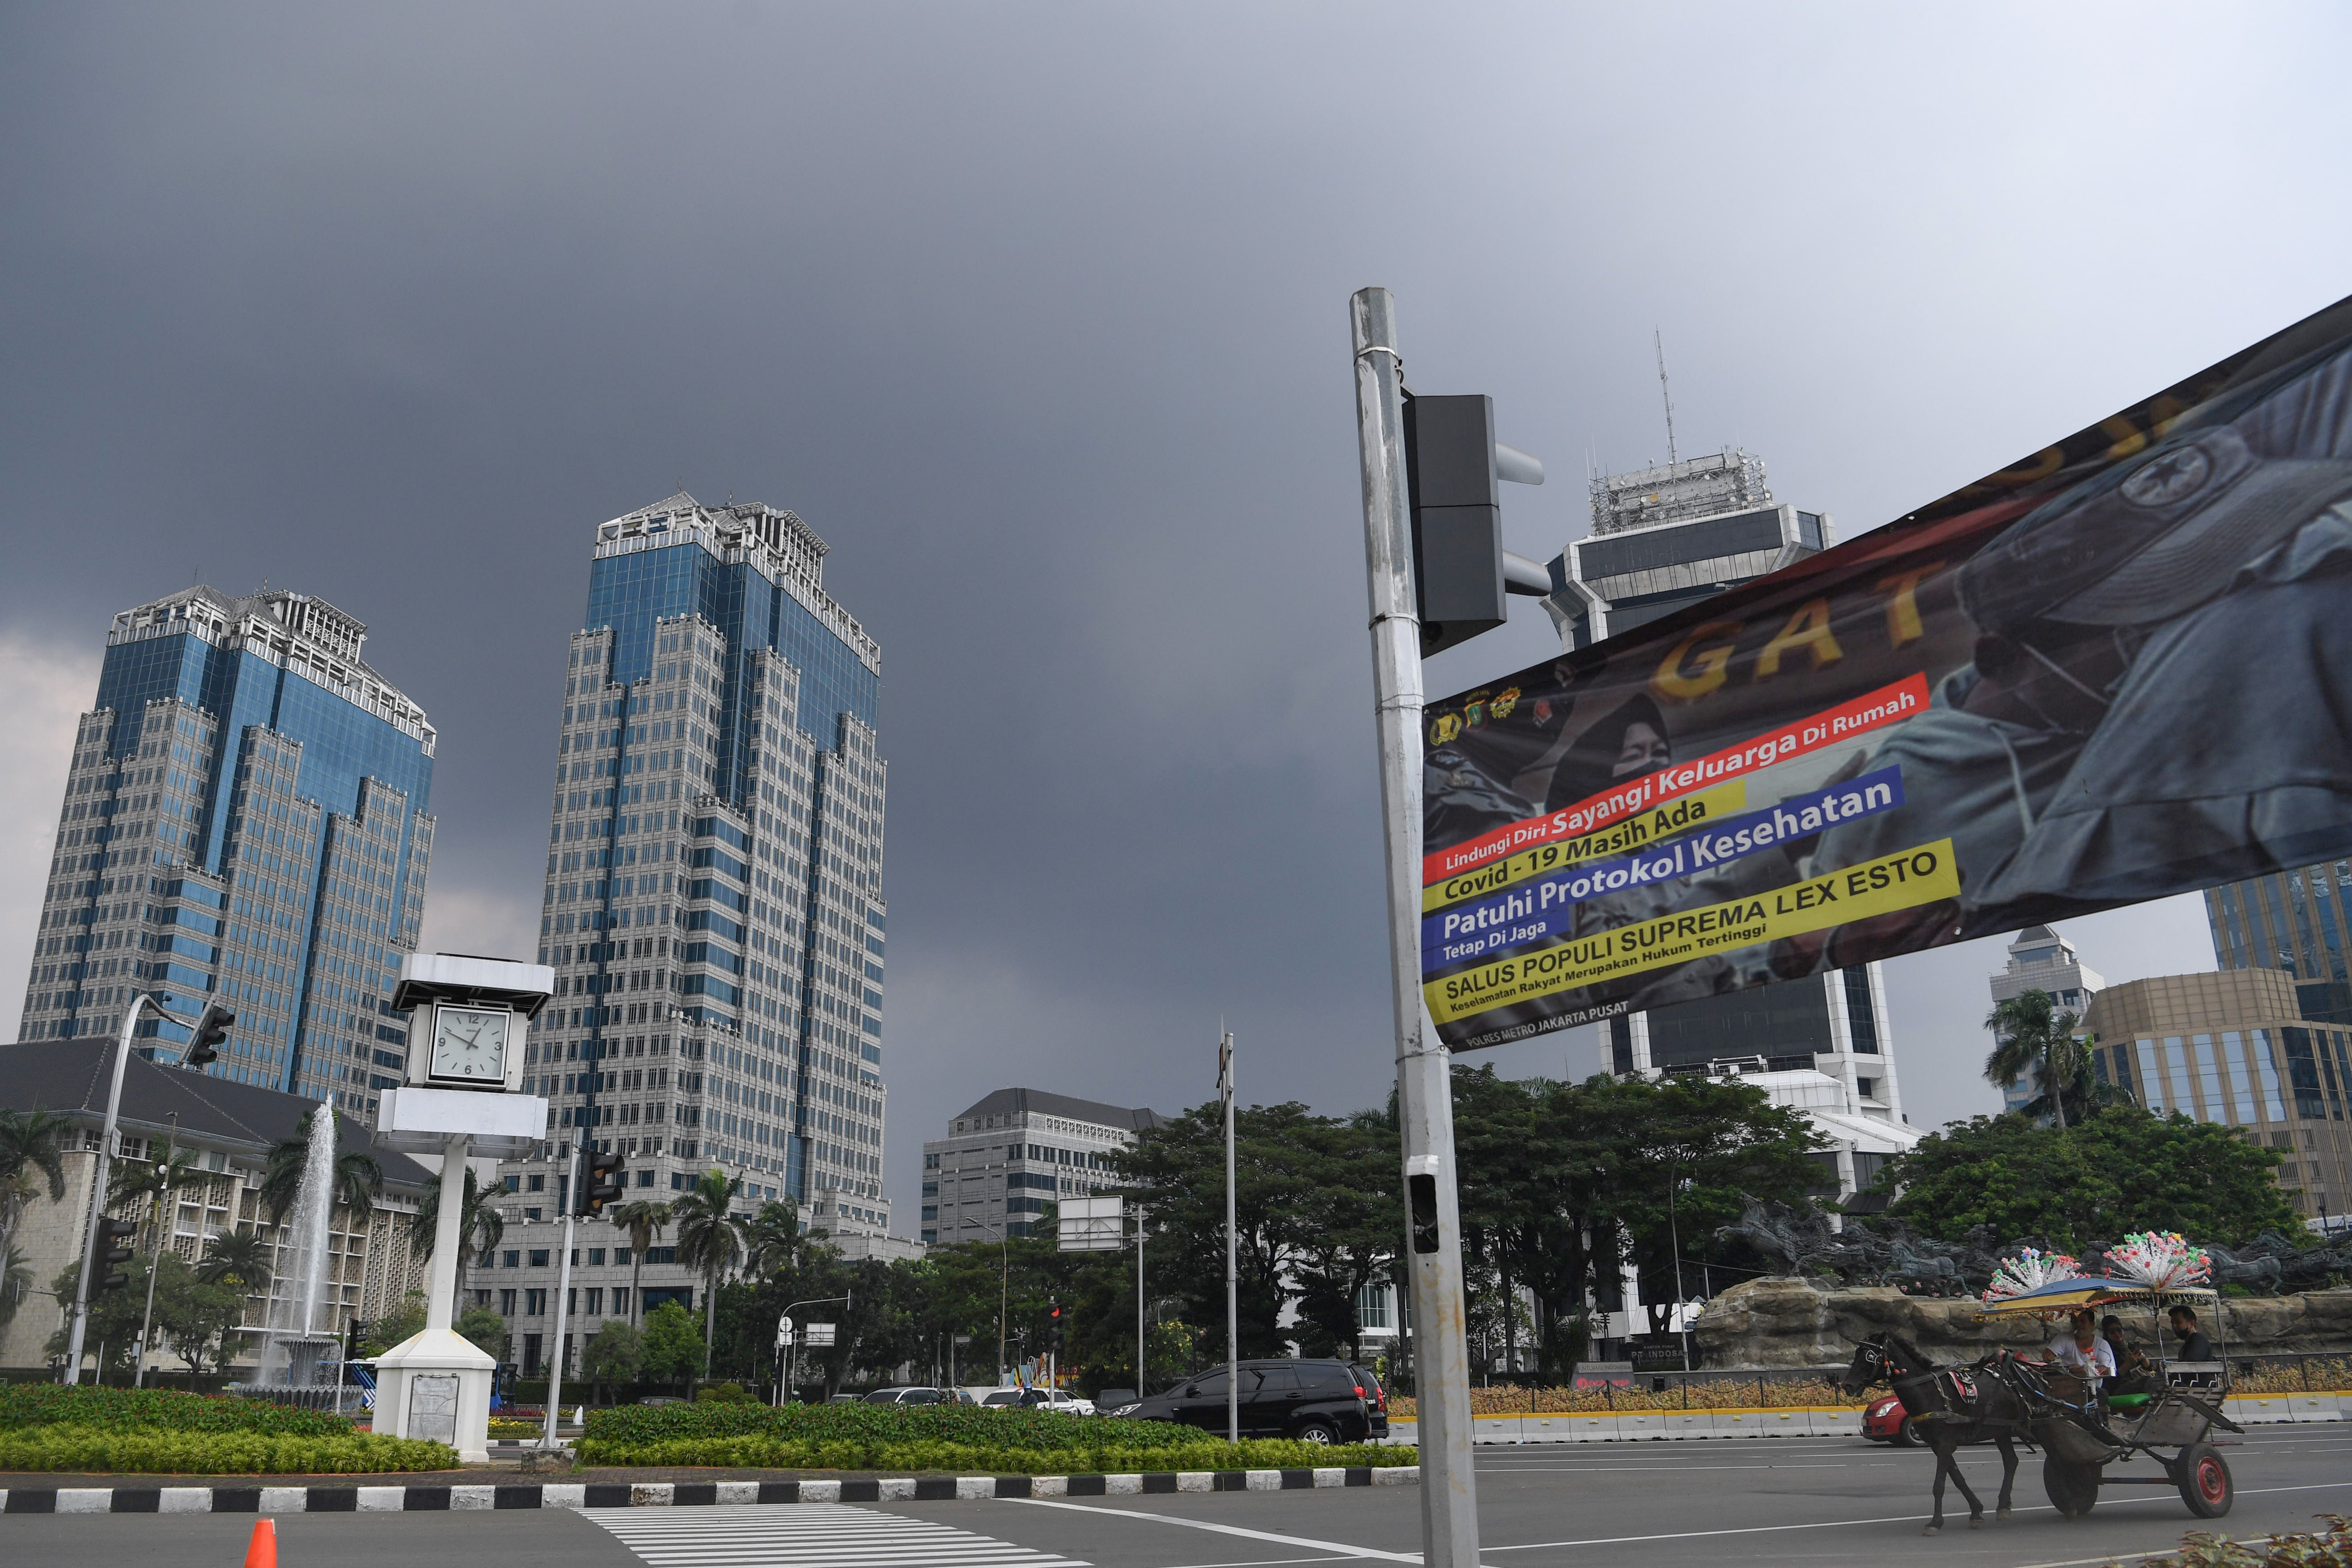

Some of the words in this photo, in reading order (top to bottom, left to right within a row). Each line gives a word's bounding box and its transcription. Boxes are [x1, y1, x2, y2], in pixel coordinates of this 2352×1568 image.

[1446, 834, 1510, 870] Lindungi
[1514, 824, 1547, 844] Diri
[1551, 779, 1651, 835] Sayangi
[1659, 734, 1797, 795] Keluarga
[1803, 723, 1827, 746] Di
[1833, 692, 1915, 735] Rumah
[1444, 889, 1533, 939] Patuhi
[1540, 845, 1684, 910] Protokol
[1691, 782, 1892, 868] Kesehatan
[1445, 861, 1508, 899] Covid
[1528, 847, 1558, 870] 19
[1566, 818, 1647, 861] Masih
[1654, 801, 1706, 835] Ada
[1443, 940, 1484, 960] Tetap
[1489, 933, 1506, 948] Di
[1509, 921, 1547, 942] Jaga
[1446, 964, 1515, 1000] SALUS
[1523, 937, 1612, 978] POPULI
[1620, 901, 1766, 952] SUPREMA
[1776, 879, 1839, 915] LEX
[1847, 851, 1937, 897] ESTO
[1450, 987, 1516, 1013] Keselamatan
[1521, 975, 1561, 993] Rakyat
[1565, 956, 1638, 982] Merupakan
[1642, 943, 1692, 962] Hukum
[1699, 923, 1766, 949] Tertinggi
[468, 1014, 479, 1024] 12
[1467, 1032, 1500, 1047] POLRES
[1501, 1024, 1536, 1040] METRO
[1538, 1011, 1587, 1032] JAKARTA
[1589, 1000, 1629, 1020] PUSAT
[438, 1037, 446, 1047] 9
[494, 1041, 502, 1051] 3
[465, 1065, 471, 1074] 6
[1649, 1350, 1684, 1358] INDOSA
